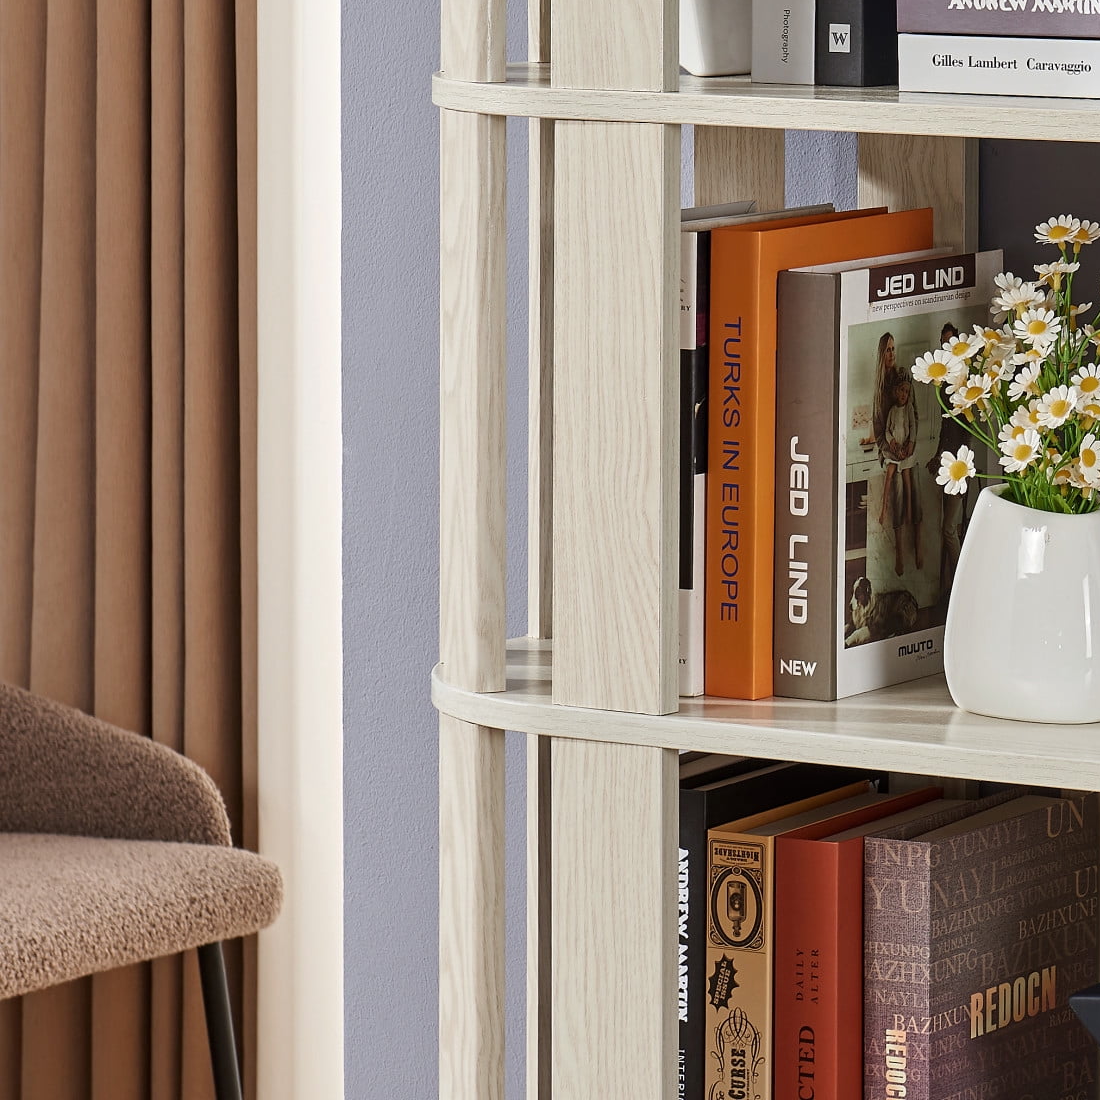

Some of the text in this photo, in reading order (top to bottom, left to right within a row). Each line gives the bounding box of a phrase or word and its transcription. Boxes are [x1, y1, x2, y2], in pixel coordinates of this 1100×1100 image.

[781, 9, 791, 64] Photography
[831, 32, 848, 46] W
[932, 54, 1092, 75] Gilles Lambert Caravaggio
[877, 266, 964, 297] JED LIND
[884, 299, 914, 313] perspectives
[720, 316, 741, 622] TURKS IN EUROPE
[788, 435, 810, 625] JED LIND
[780, 659, 817, 676] NEW
[898, 640, 933, 657] MUUTO
[713, 960, 728, 1005] SPECIAL
[719, 968, 731, 1000] ISSUE
[796, 949, 805, 1001] DAILY
[810, 949, 819, 1004] ALTER
[970, 965, 1056, 1039] REDOCN
[728, 1048, 746, 1100] CURSE
[886, 1029, 907, 1100] REDOC
